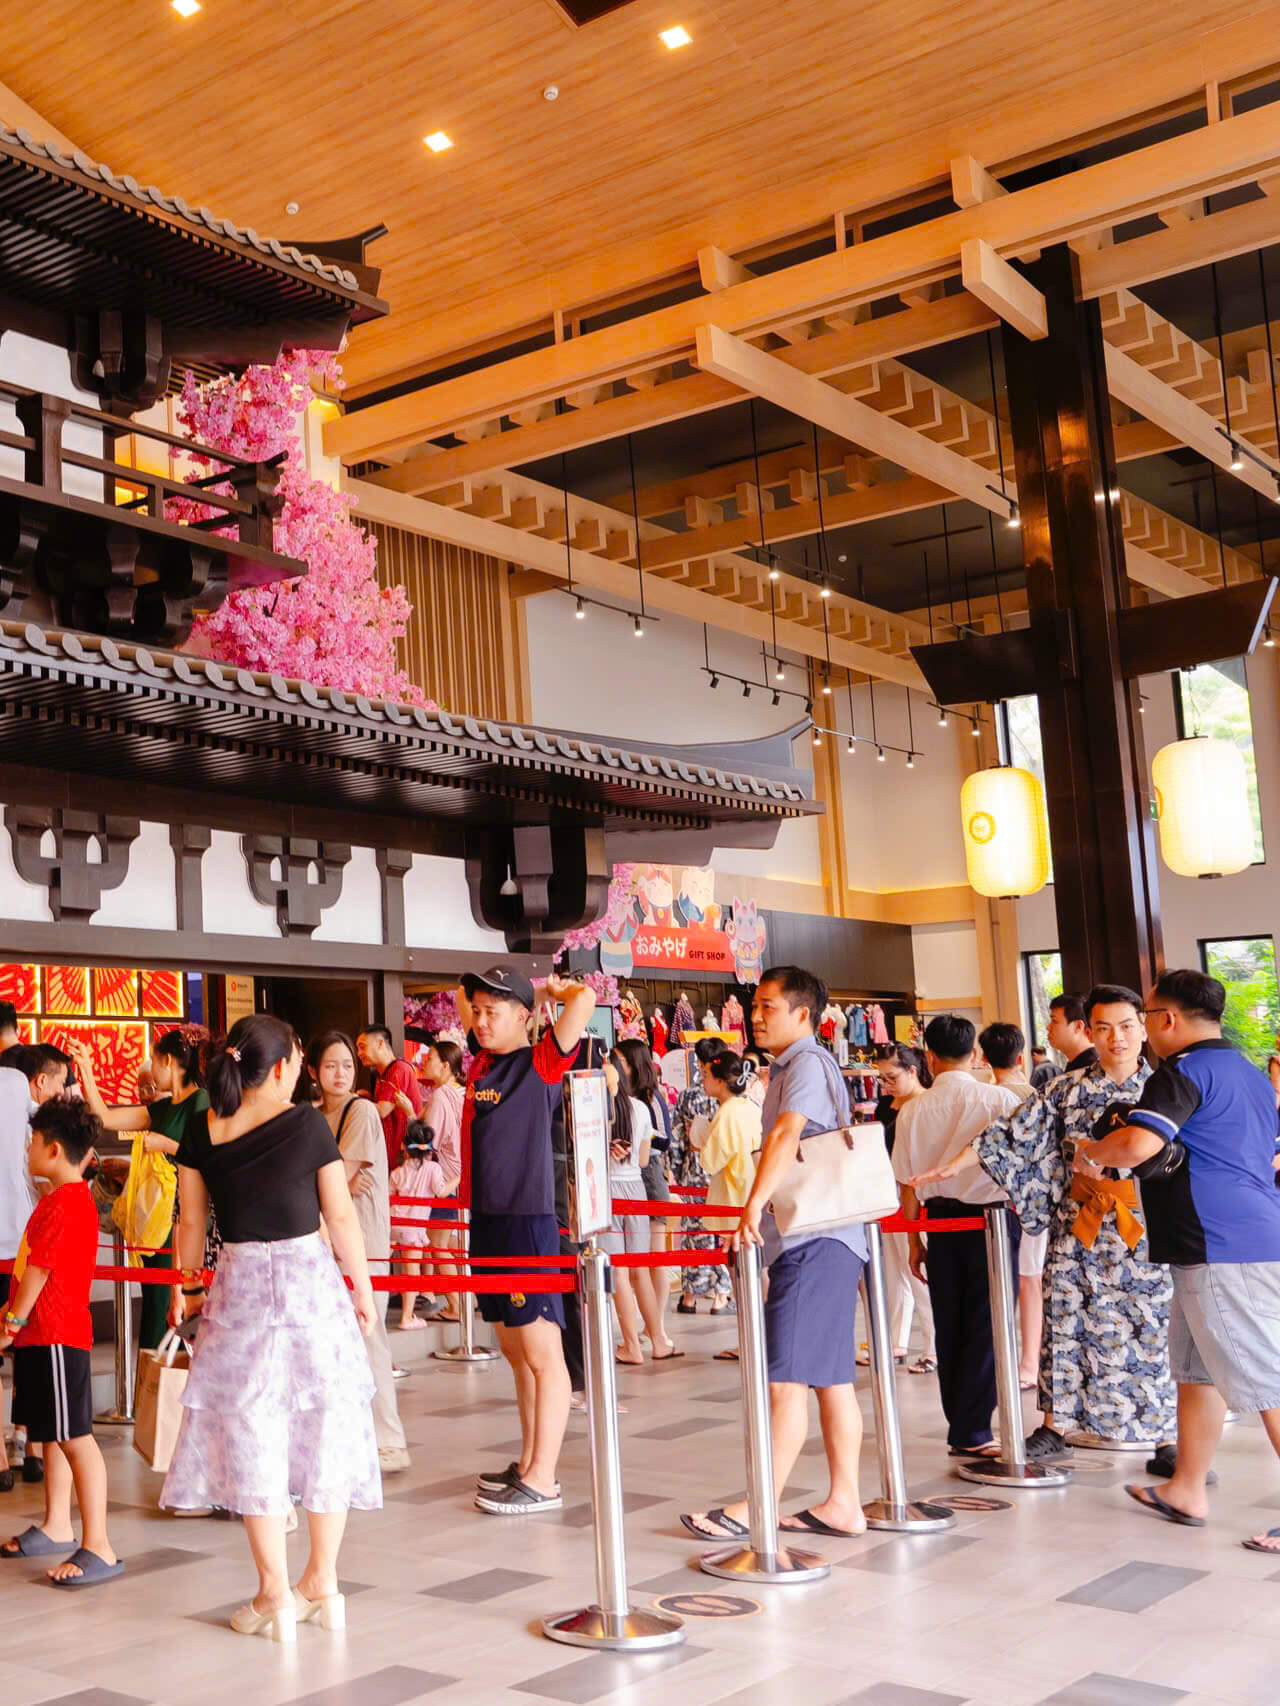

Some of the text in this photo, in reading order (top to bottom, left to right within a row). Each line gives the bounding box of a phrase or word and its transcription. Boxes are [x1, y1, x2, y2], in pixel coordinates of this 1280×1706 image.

[636, 935, 688, 958] おみやげ
[689, 950, 725, 960] GIFT SHOP
